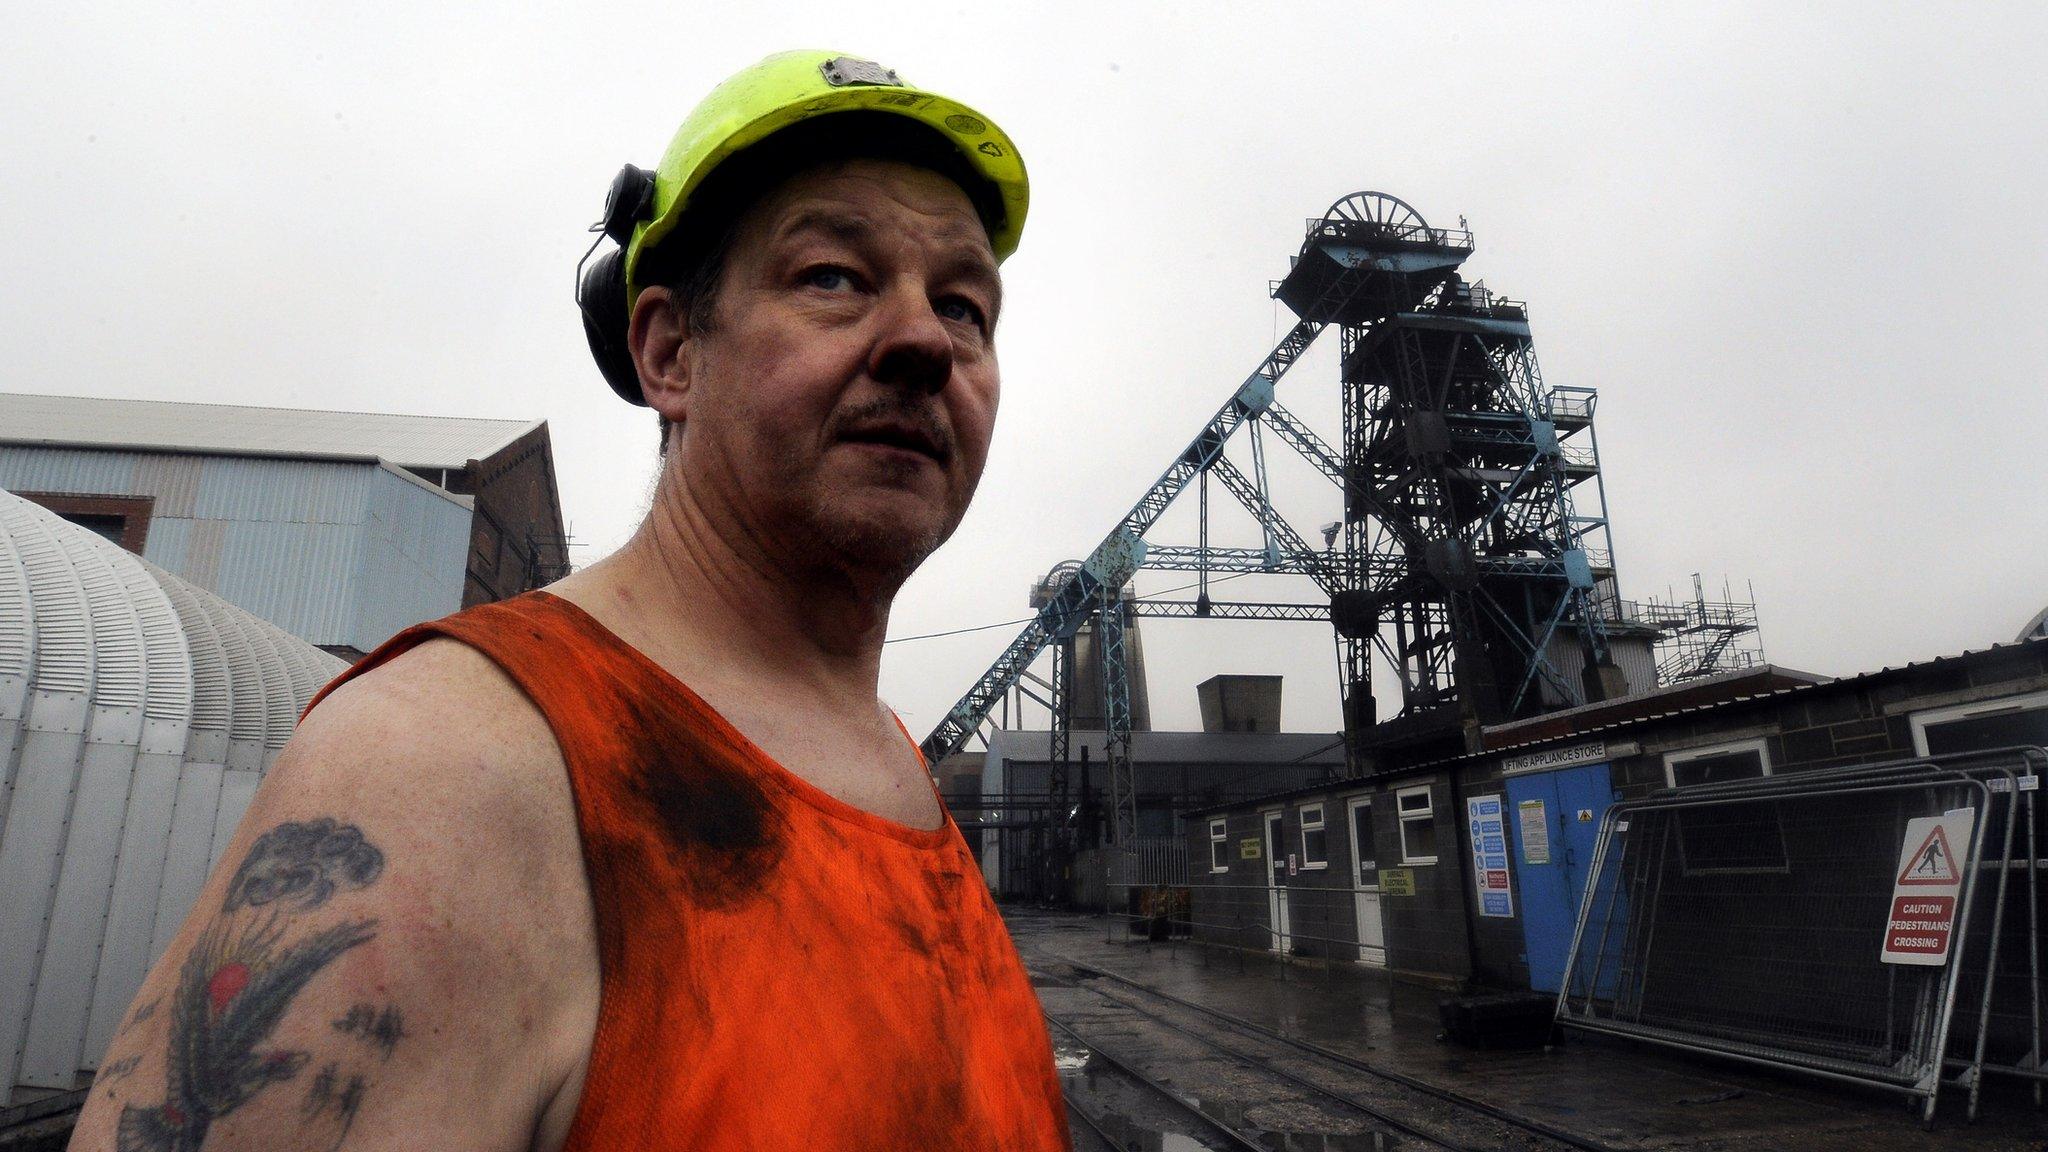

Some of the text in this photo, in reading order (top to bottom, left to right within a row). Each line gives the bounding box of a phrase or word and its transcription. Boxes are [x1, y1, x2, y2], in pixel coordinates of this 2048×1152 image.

[1502, 744, 1603, 771] LIFTING APPLIANCE STORE
[1903, 904, 1942, 914] CAUTION
[1890, 920, 1950, 931] PEDESTRIANS
[1894, 937, 1939, 948] CROSSING
